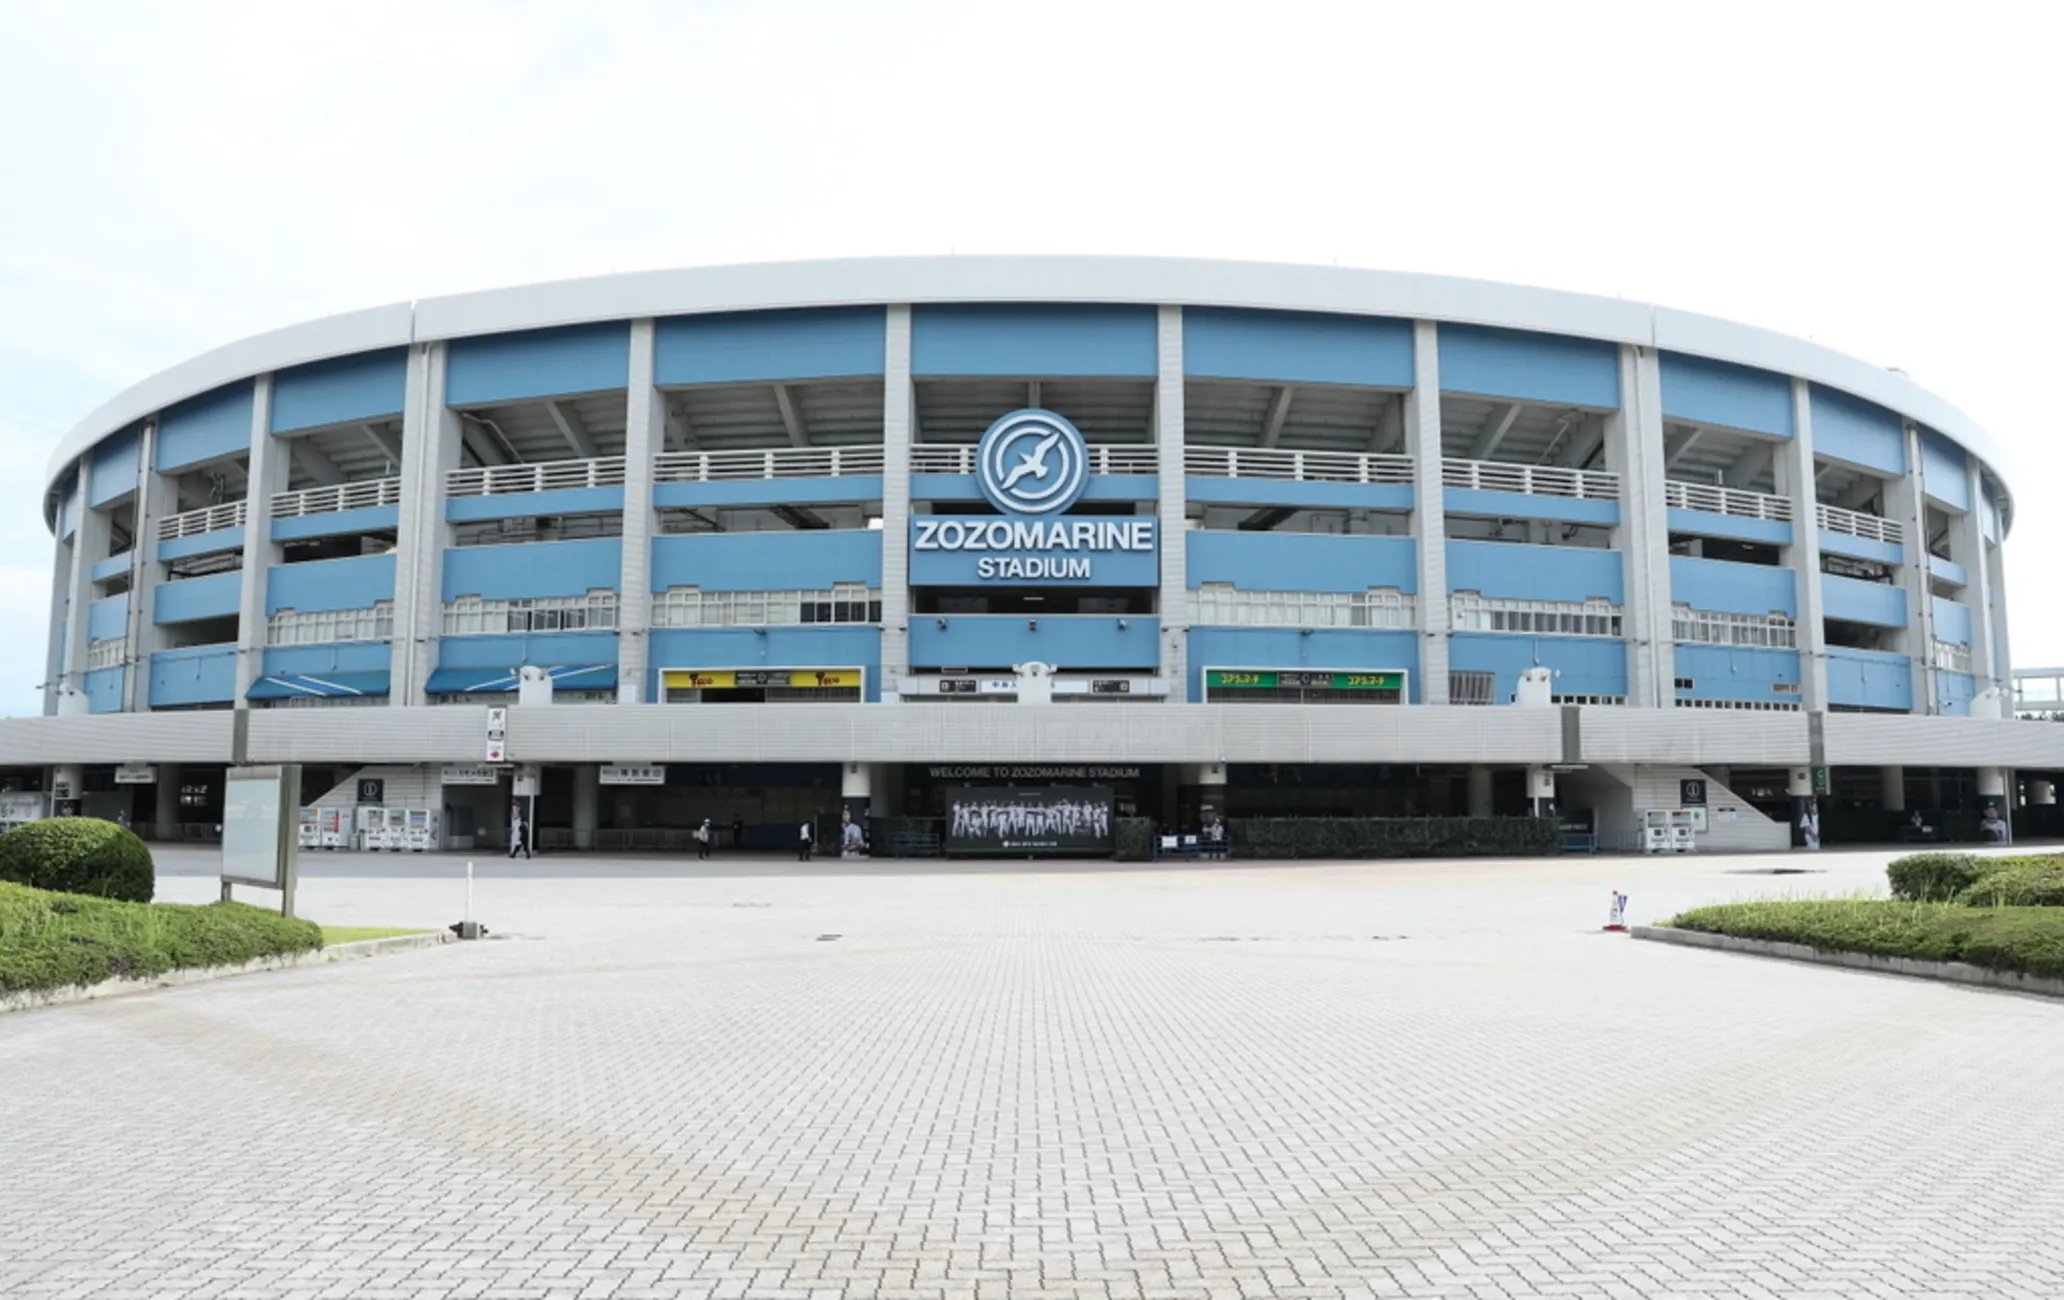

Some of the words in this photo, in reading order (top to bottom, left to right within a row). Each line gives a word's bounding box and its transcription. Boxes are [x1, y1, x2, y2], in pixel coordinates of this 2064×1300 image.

[915, 520, 1153, 551] ZOZOMARINE
[977, 557, 1090, 578] STADIUM
[929, 766, 990, 779] WELCOME
[993, 766, 1009, 779] TO
[1011, 766, 1086, 779] ZOZOMARINE
[1088, 766, 1140, 779] STADIUM
